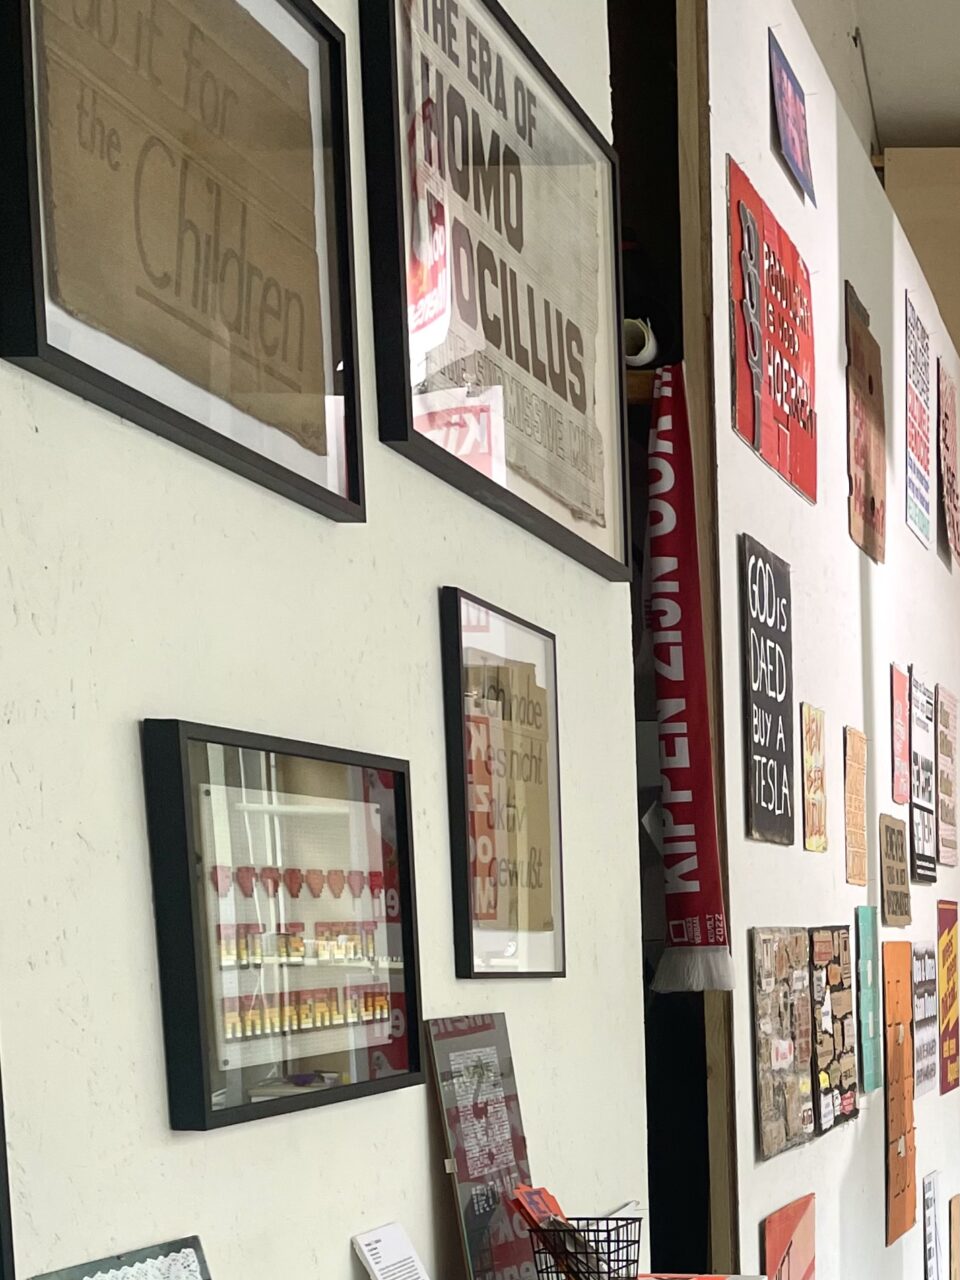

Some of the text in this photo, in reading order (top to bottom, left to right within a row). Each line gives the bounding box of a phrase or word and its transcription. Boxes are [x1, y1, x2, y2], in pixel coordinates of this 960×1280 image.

[466, 16, 508, 121] ERA
[514, 75, 537, 149] OF
[76, 82, 123, 172] the
[420, 52, 524, 254] HOMO
[133, 134, 306, 372] Children
[748, 554, 788, 632] GOD IS
[750, 627, 787, 703] DAED
[509, 738, 544, 786] nicht
[752, 703, 786, 752] BUY A
[753, 754, 792, 818] TESLA
